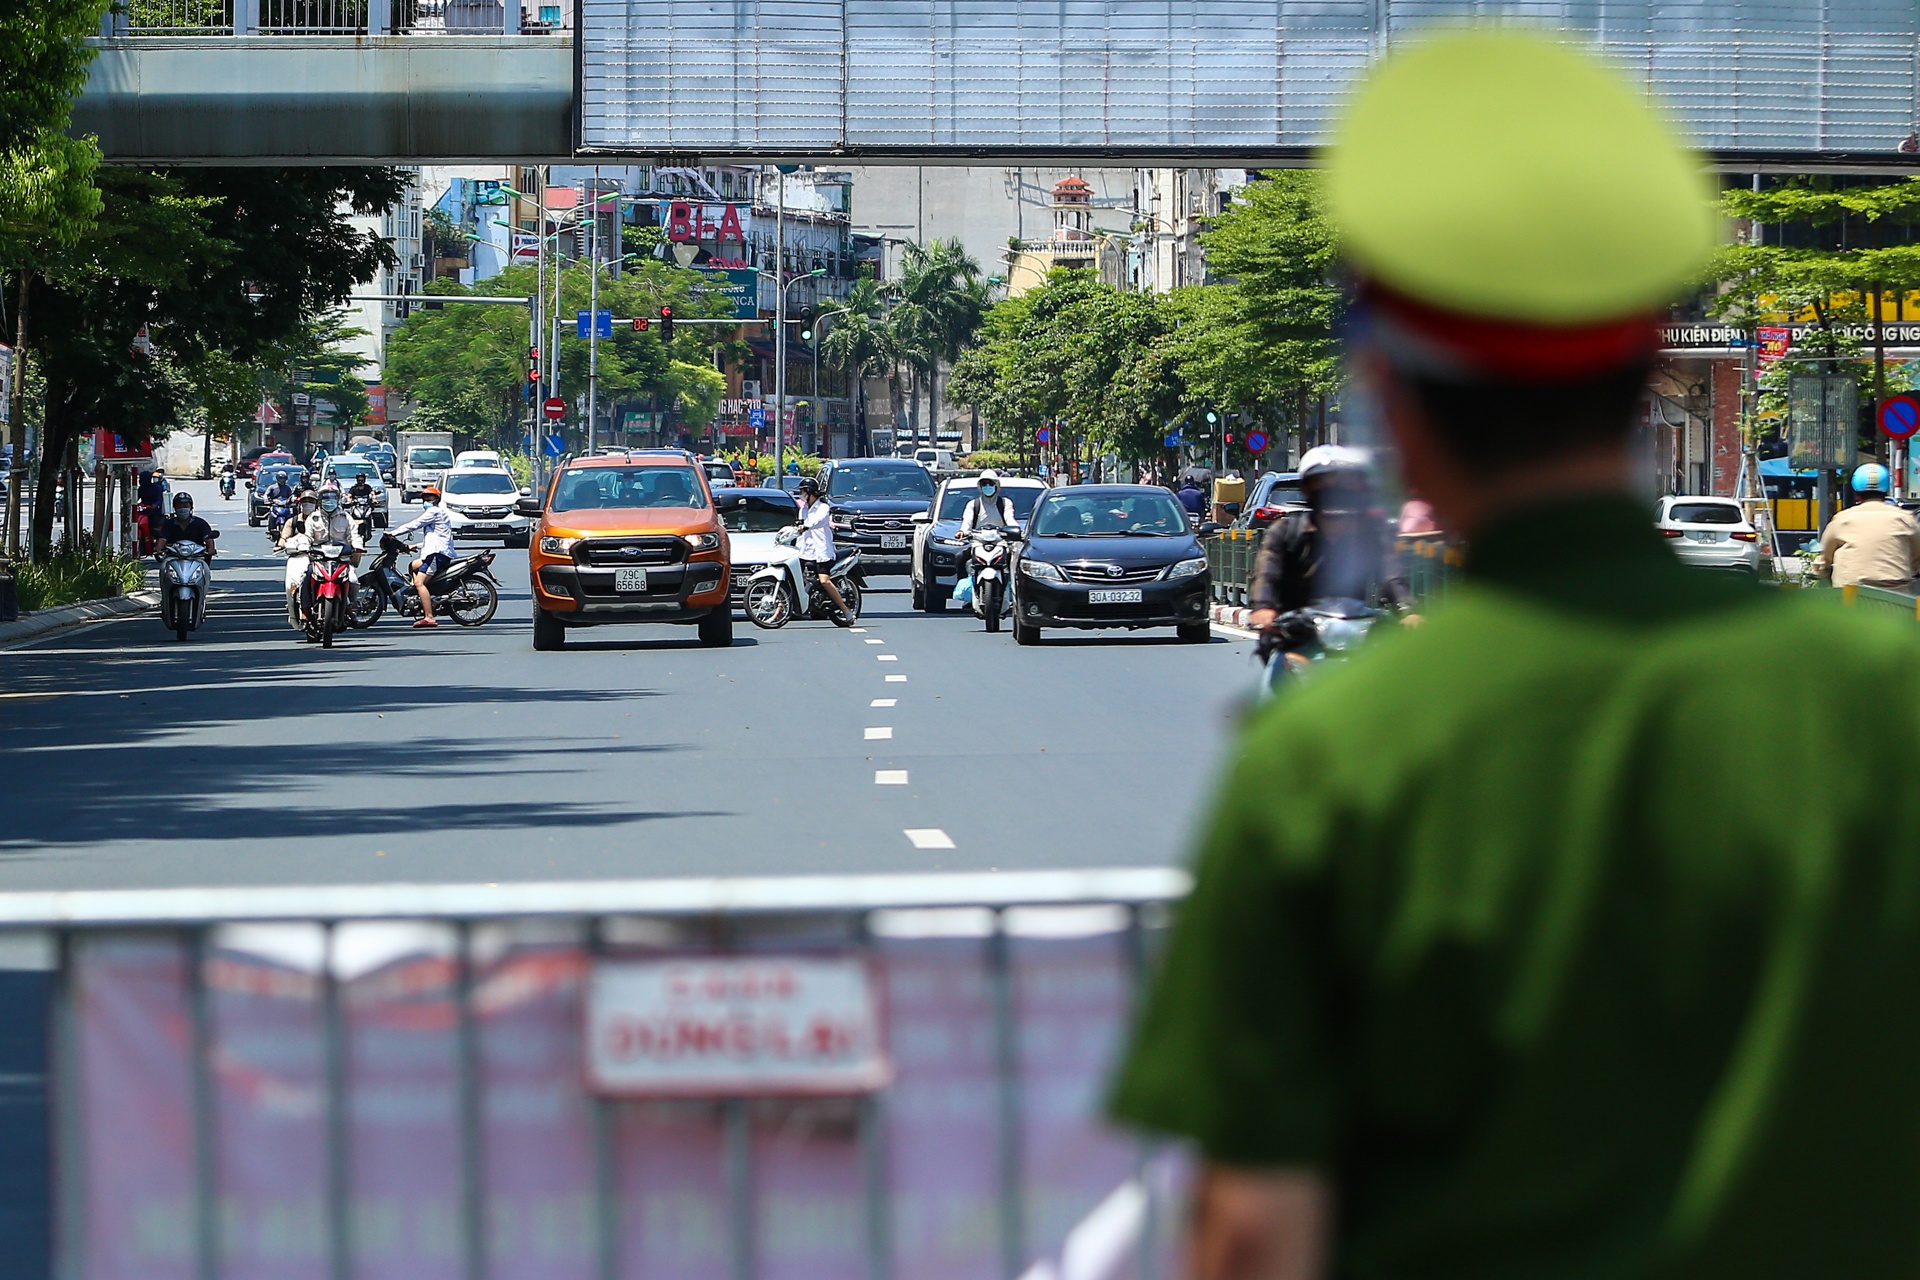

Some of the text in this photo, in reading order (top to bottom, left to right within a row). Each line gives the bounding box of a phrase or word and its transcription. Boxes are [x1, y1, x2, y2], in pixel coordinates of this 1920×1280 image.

[1681, 325, 1710, 346] KIỆN
[1711, 325, 1740, 346] ĐIỆN
[1852, 323, 1898, 341] CÔG
[622, 570, 639, 579] 29C
[616, 580, 646, 590] 656.68
